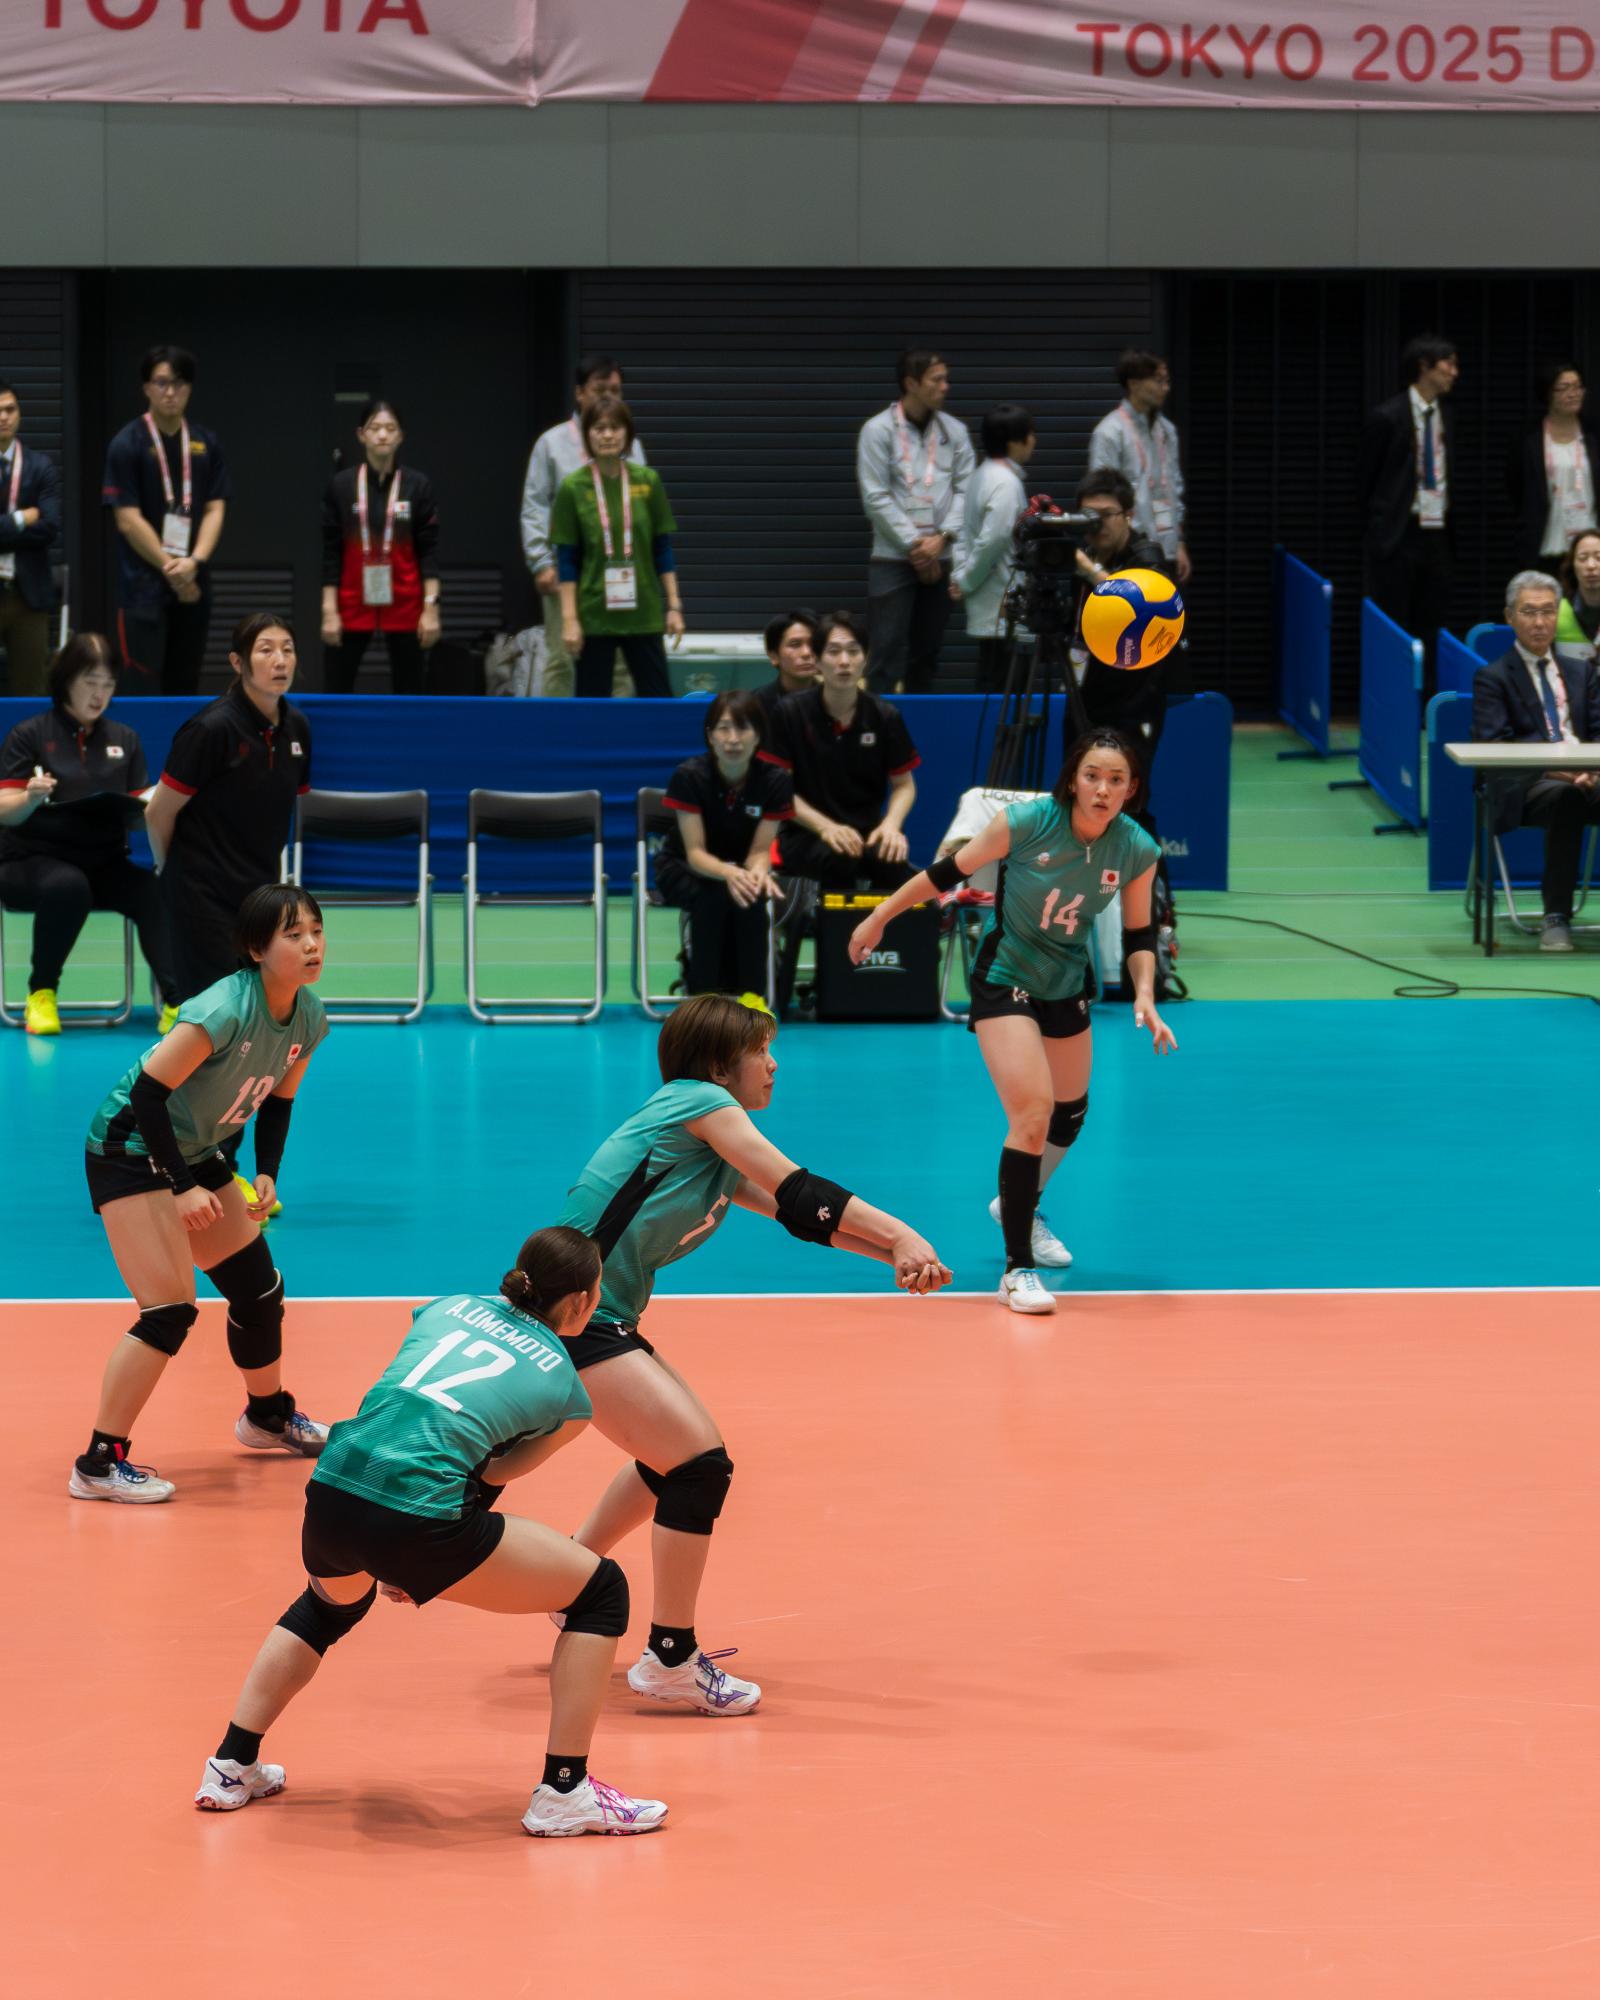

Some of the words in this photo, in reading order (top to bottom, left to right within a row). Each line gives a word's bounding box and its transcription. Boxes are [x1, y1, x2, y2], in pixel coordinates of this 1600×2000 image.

[1075, 22, 1323, 80] TOKYO
[1352, 24, 1524, 83] 2025
[1549, 26, 1595, 82] D
[1040, 887, 1085, 935] 14
[216, 1075, 275, 1124] 13
[445, 1298, 564, 1373] A.UMEMOTO
[399, 1329, 517, 1414] 12
